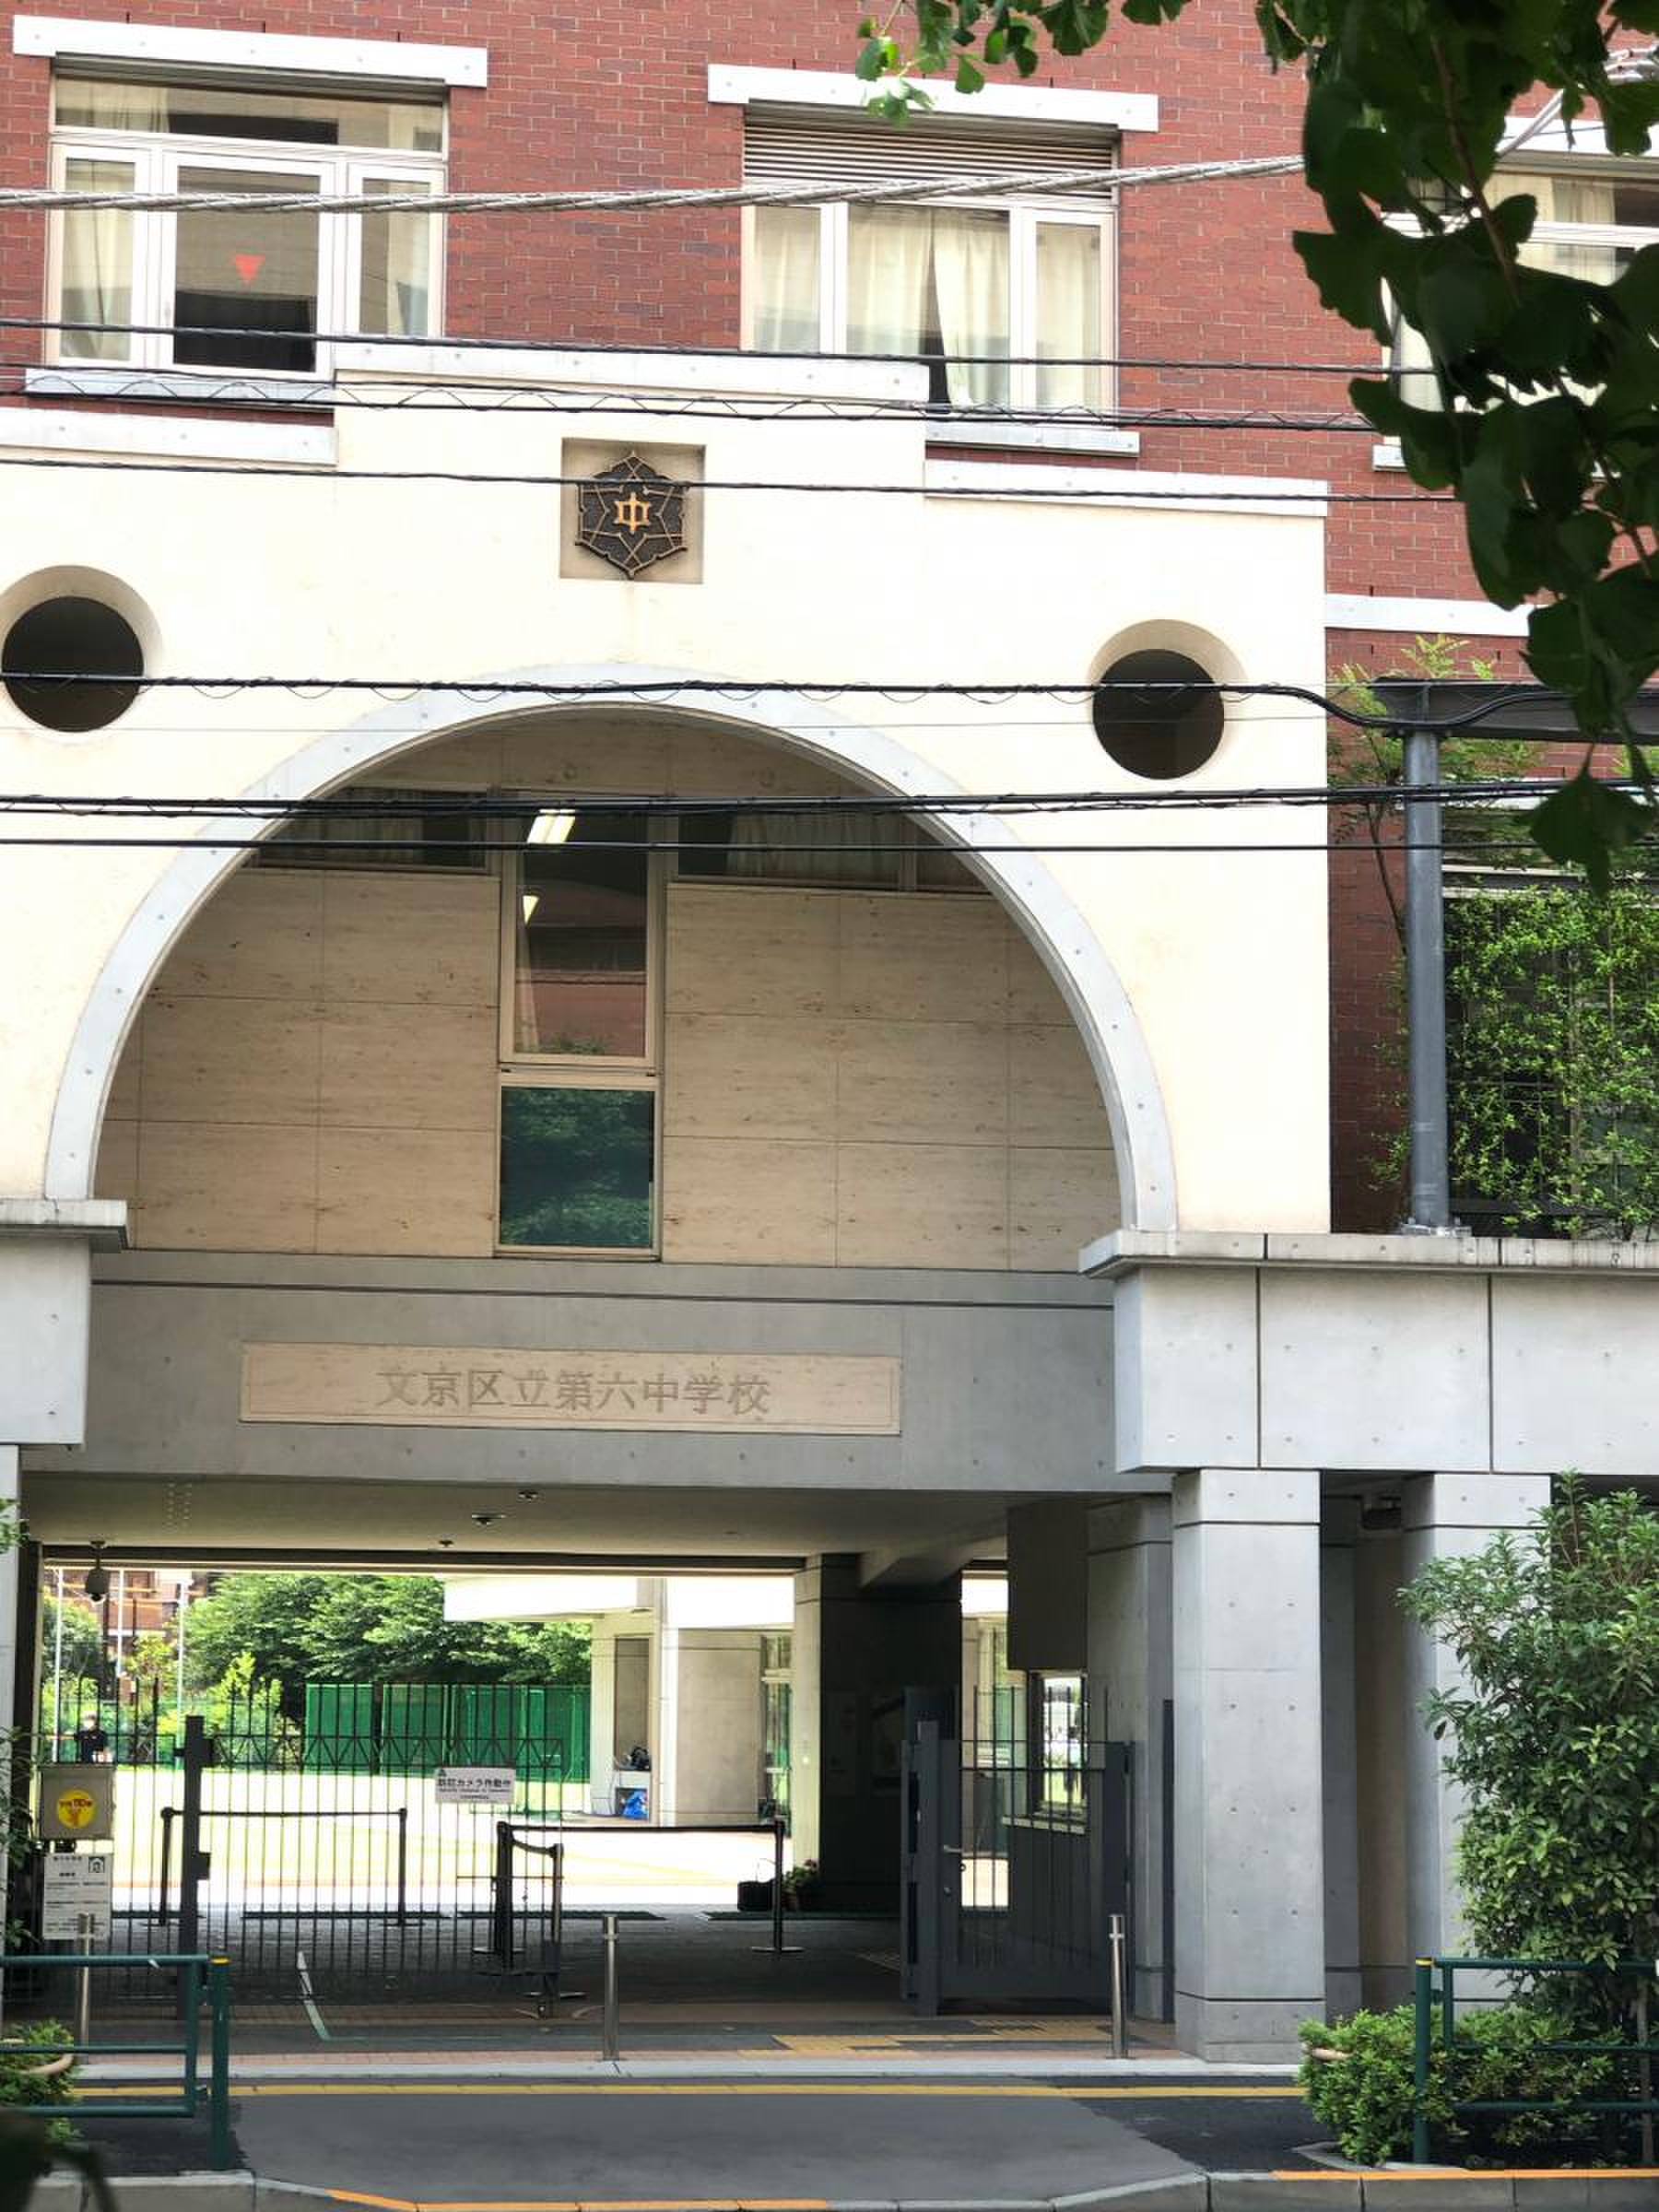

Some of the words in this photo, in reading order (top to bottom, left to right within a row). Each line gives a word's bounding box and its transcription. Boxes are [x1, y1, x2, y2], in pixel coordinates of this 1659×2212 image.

[375, 1366, 771, 1416] 文京区立第六中学校
